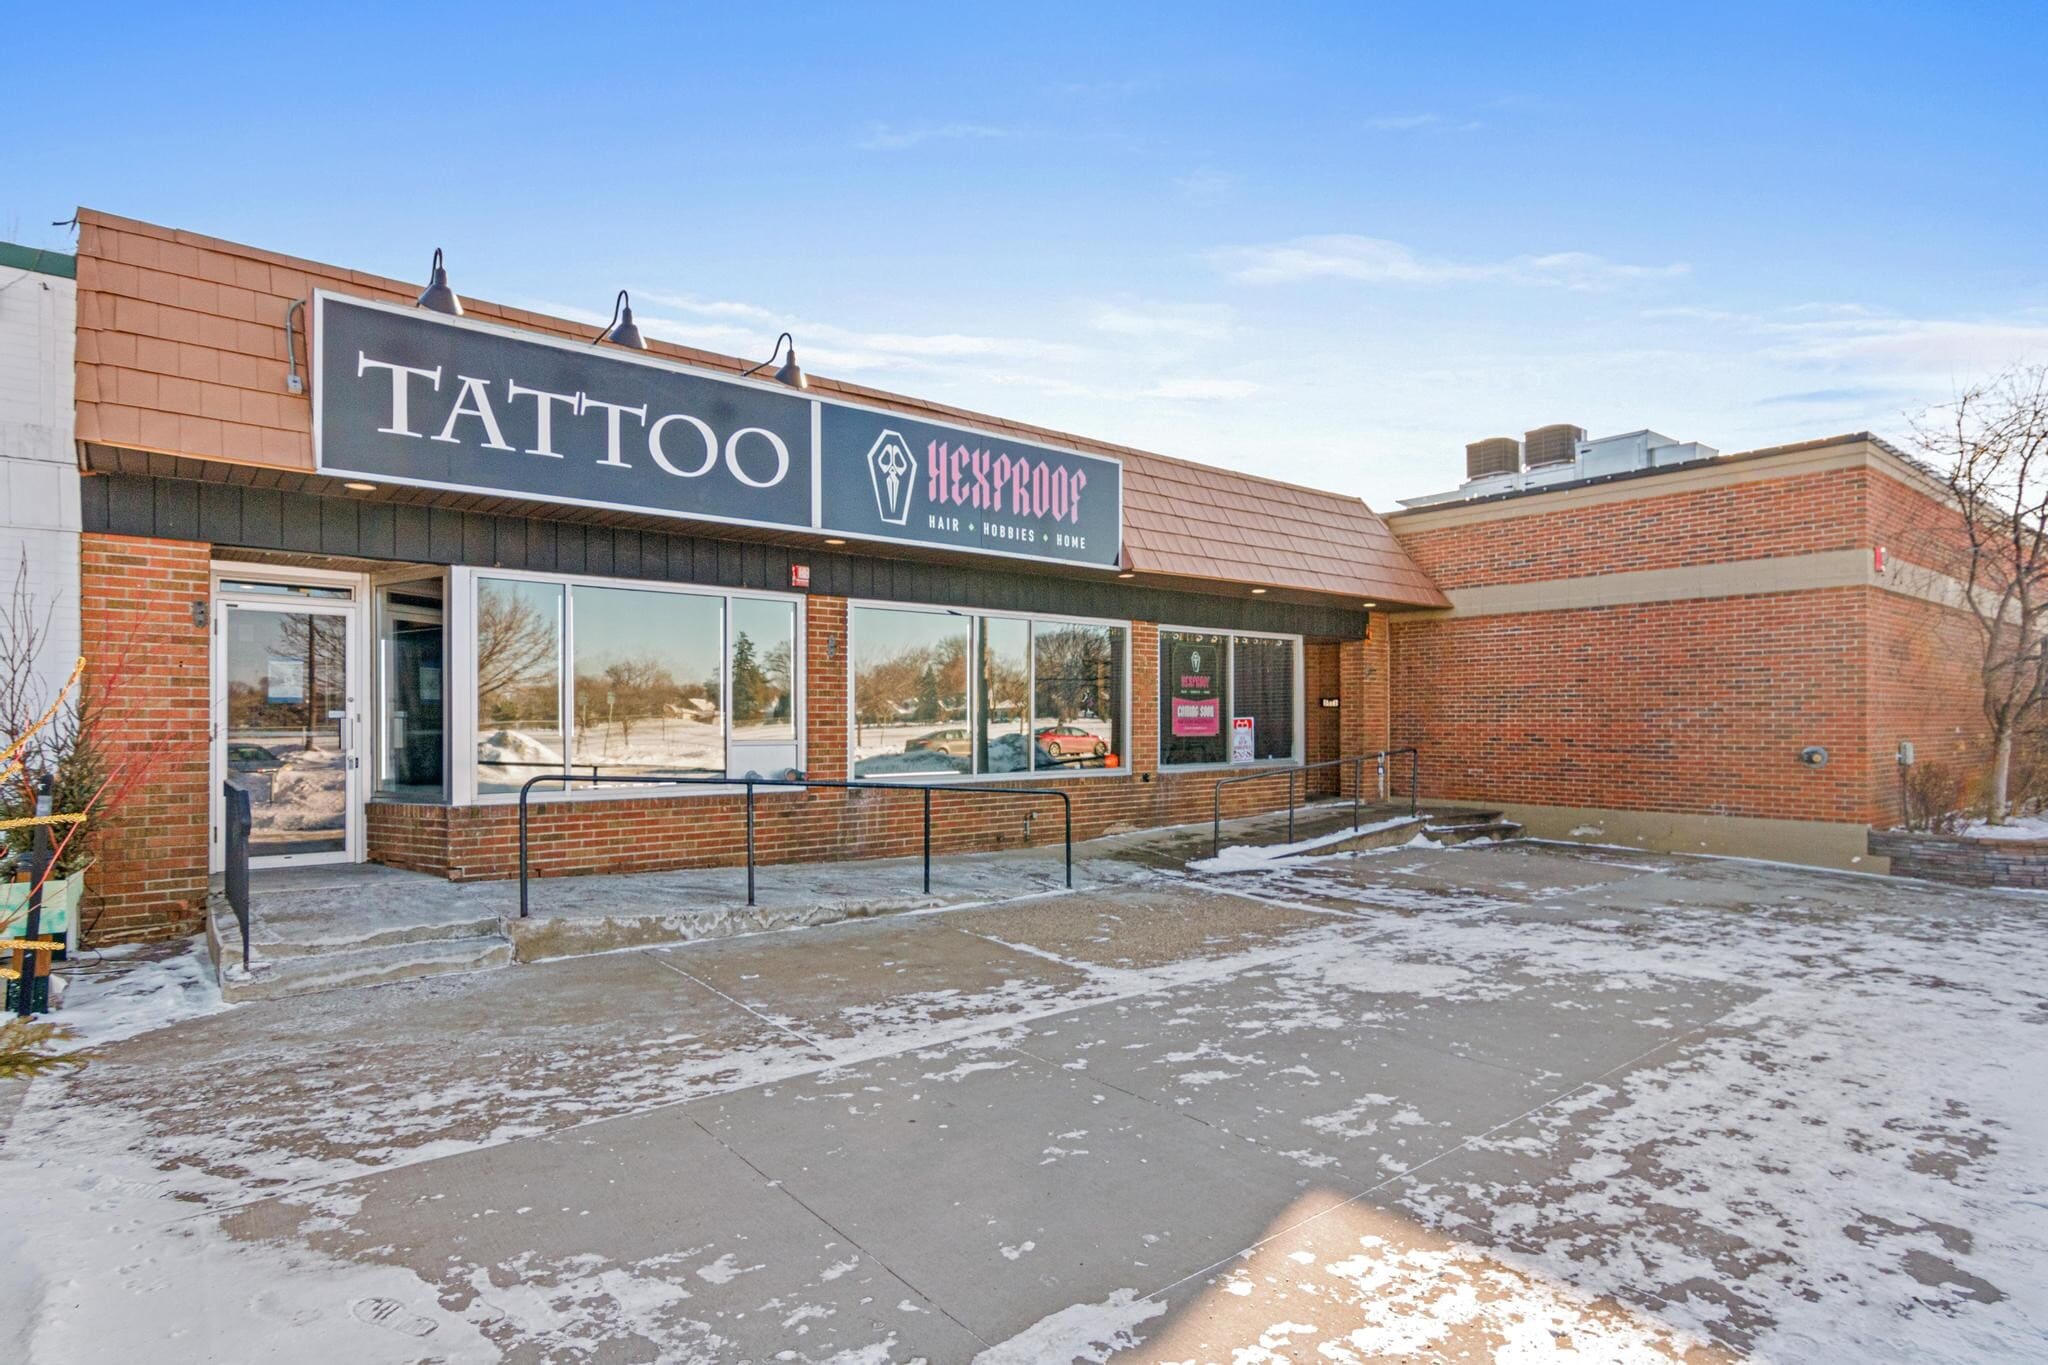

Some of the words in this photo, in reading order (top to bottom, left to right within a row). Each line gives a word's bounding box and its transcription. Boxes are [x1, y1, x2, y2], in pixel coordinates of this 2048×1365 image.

[357, 350, 790, 488] TATTOO
[927, 439, 1088, 525] HEXPROOF
[928, 515, 960, 533] HAIR
[983, 522, 1035, 543] HOBBIES
[1056, 533, 1086, 549] HOME
